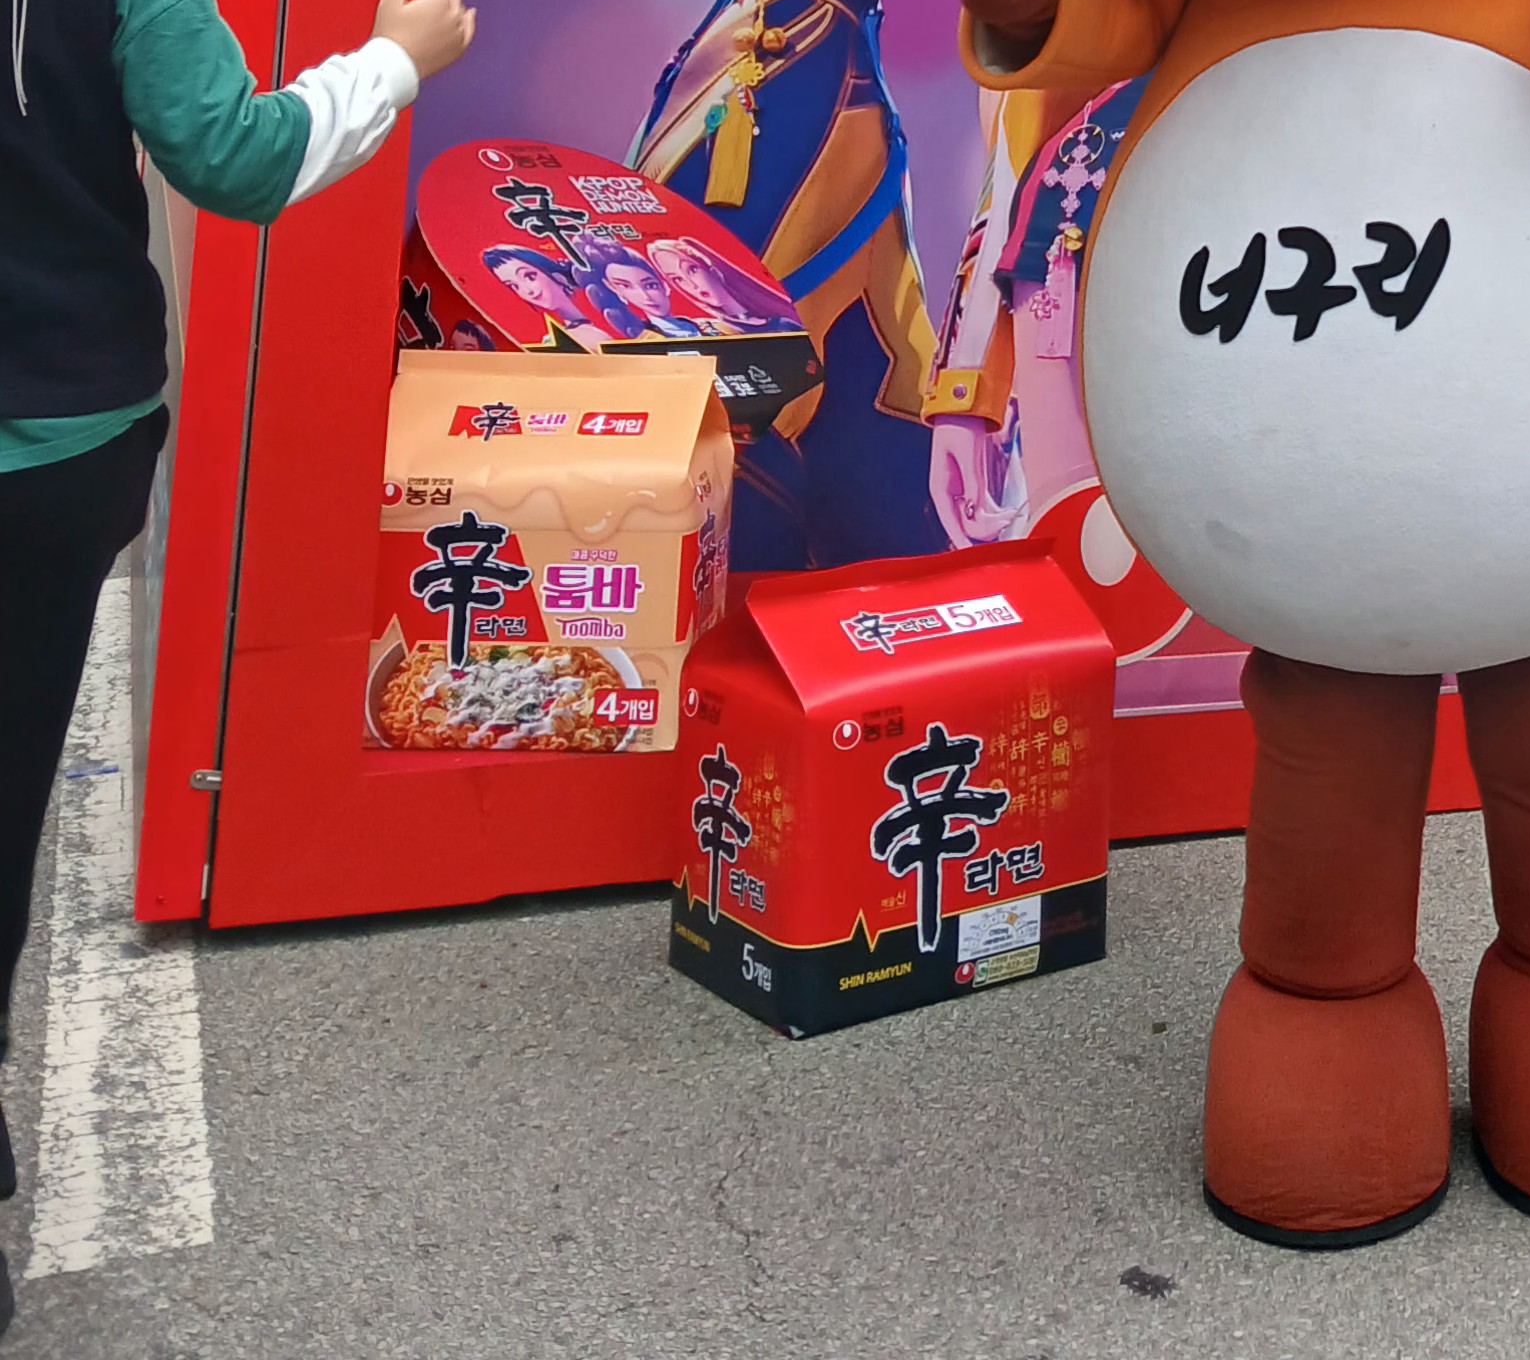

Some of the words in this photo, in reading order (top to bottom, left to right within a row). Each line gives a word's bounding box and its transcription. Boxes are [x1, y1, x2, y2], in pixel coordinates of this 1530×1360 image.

[492, 176, 590, 272] 辛
[592, 201, 667, 214] HUNTERS
[1180, 217, 1452, 343] 너구리
[473, 402, 520, 441] 辛
[583, 415, 643, 433] 4개입
[406, 487, 451, 505] 농심
[410, 510, 533, 670] 辛
[475, 616, 527, 638] 라면
[543, 565, 643, 611] 툼바
[556, 617, 626, 638] Toomba
[853, 611, 896, 655] 辛
[900, 616, 941, 632] 라면
[948, 605, 1014, 628] 5개입
[597, 692, 654, 721] 4개입
[692, 743, 752, 925] 辛
[729, 868, 765, 912] 라면
[870, 721, 1011, 952] 辛
[965, 842, 1045, 895] 라면
[742, 944, 772, 992] 5개입
[840, 972, 864, 990] SHIN
[866, 961, 911, 983] RAMYUN
